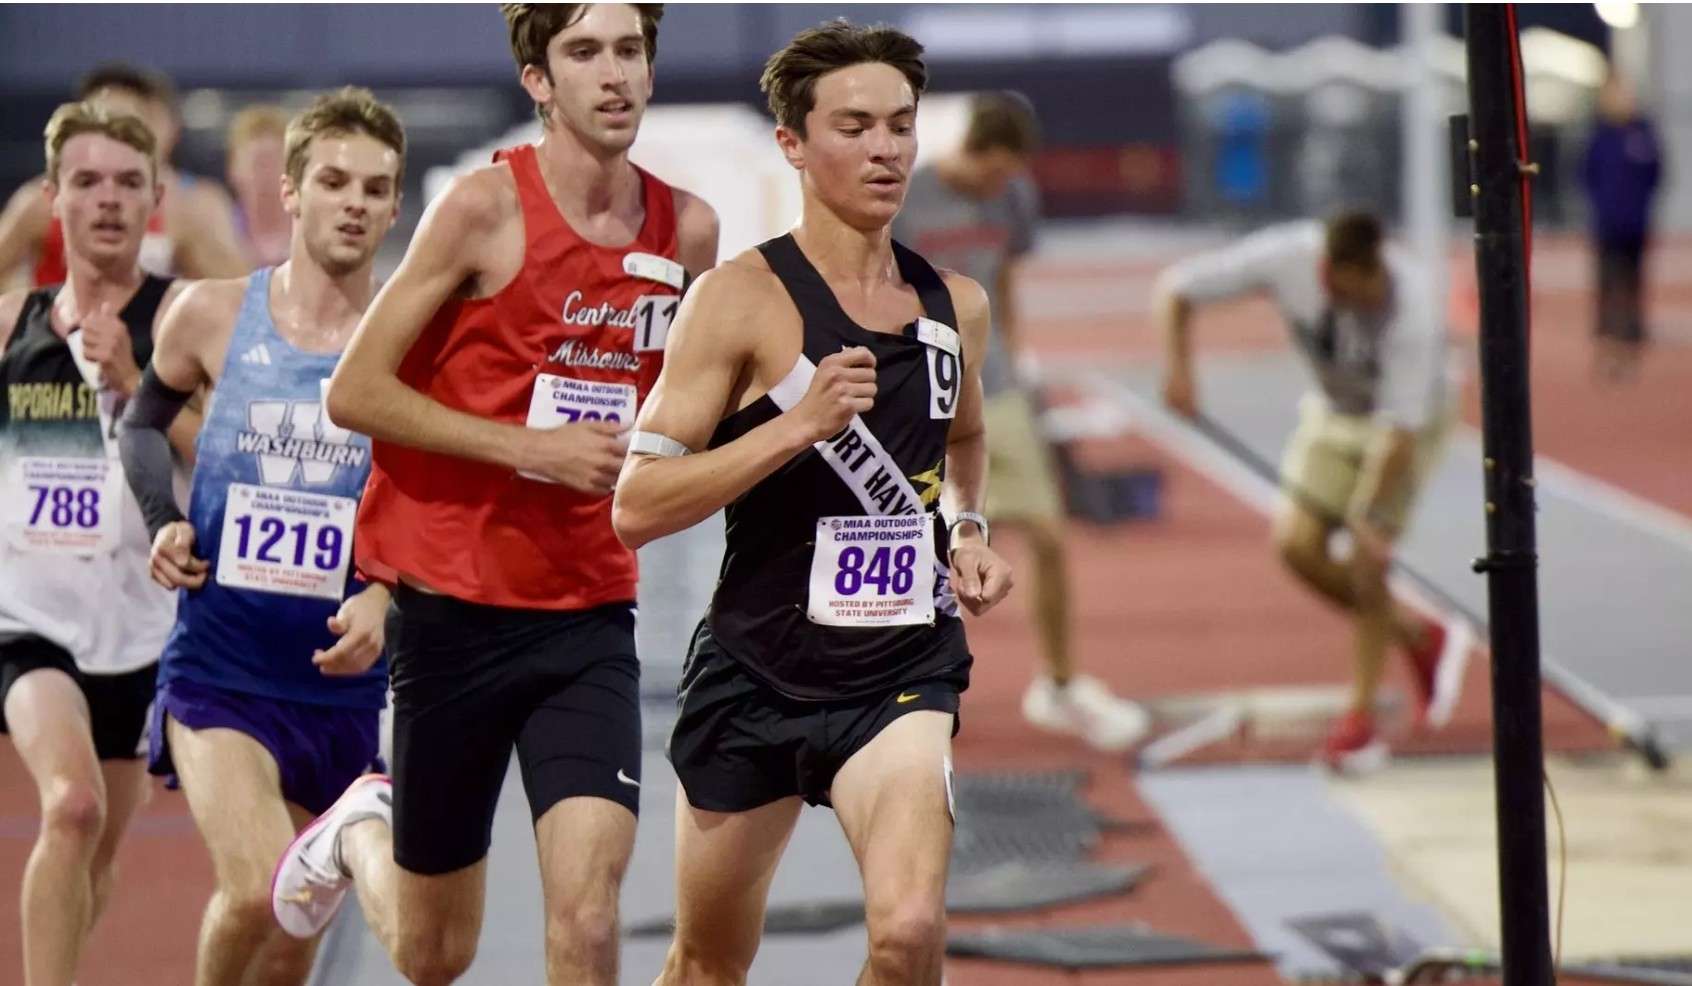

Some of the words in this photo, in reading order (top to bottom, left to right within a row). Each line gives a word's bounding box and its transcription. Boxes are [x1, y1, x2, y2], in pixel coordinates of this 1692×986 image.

[563, 290, 638, 328] Central
[548, 340, 641, 370] Missouri
[552, 391, 627, 408] CHAMPIONSHIPS
[935, 350, 958, 414] 9
[238, 432, 365, 467] WASHBURN
[28, 486, 100, 528] 788
[844, 519, 871, 528] MIAA
[874, 518, 918, 528] OUTDOOR
[235, 515, 343, 570] 1219
[834, 529, 924, 542] CHAMPIONSHIPS
[834, 545, 917, 596] 848
[836, 609, 861, 617] STATE
[864, 608, 907, 617] UNIVERSITY
